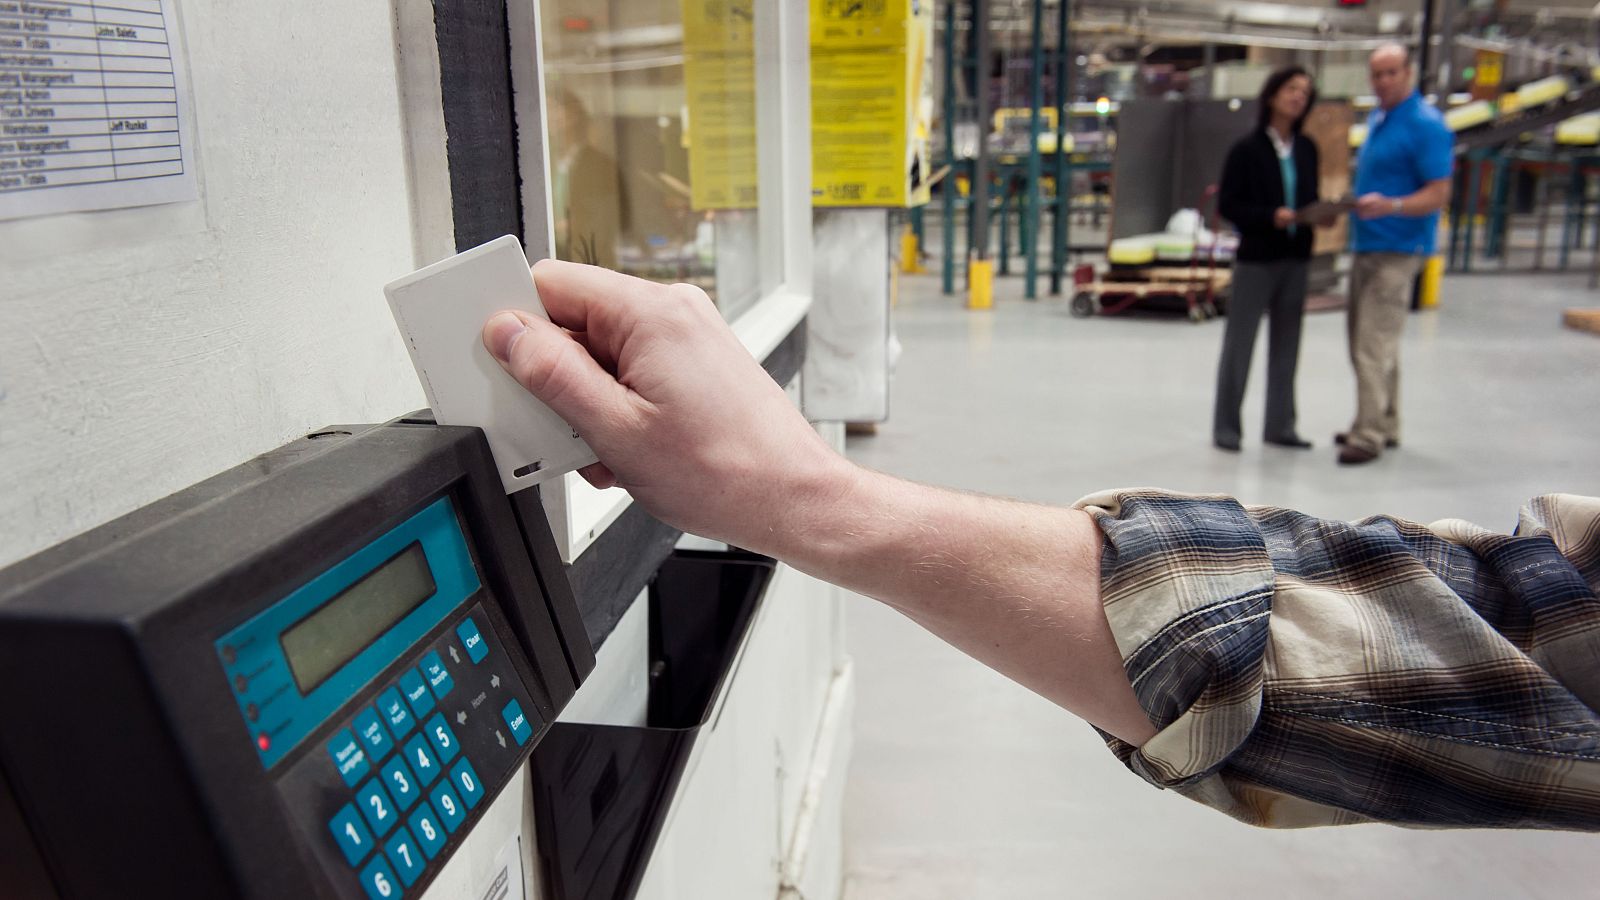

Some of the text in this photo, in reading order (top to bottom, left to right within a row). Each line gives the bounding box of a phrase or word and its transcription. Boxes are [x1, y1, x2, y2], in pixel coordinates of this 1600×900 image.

[21, 2, 72, 19] Management
[97, 25, 114, 37] John
[22, 71, 74, 87] Management
[26, 105, 55, 118] Drivers
[3, 123, 49, 135] Warehouse
[111, 119, 123, 131] Jeff
[17, 139, 70, 154] Management
[466, 633, 481, 649] Clear
[409, 685, 425, 701] Transfer
[471, 691, 487, 709] Home
[363, 722, 379, 739] Lunch
[510, 713, 524, 732] Enter
[371, 733, 382, 746] Out
[339, 750, 365, 774] Language
[345, 726, 450, 845] 1 2 3 4 5
[374, 771, 475, 897] 6 7 8 9 0
